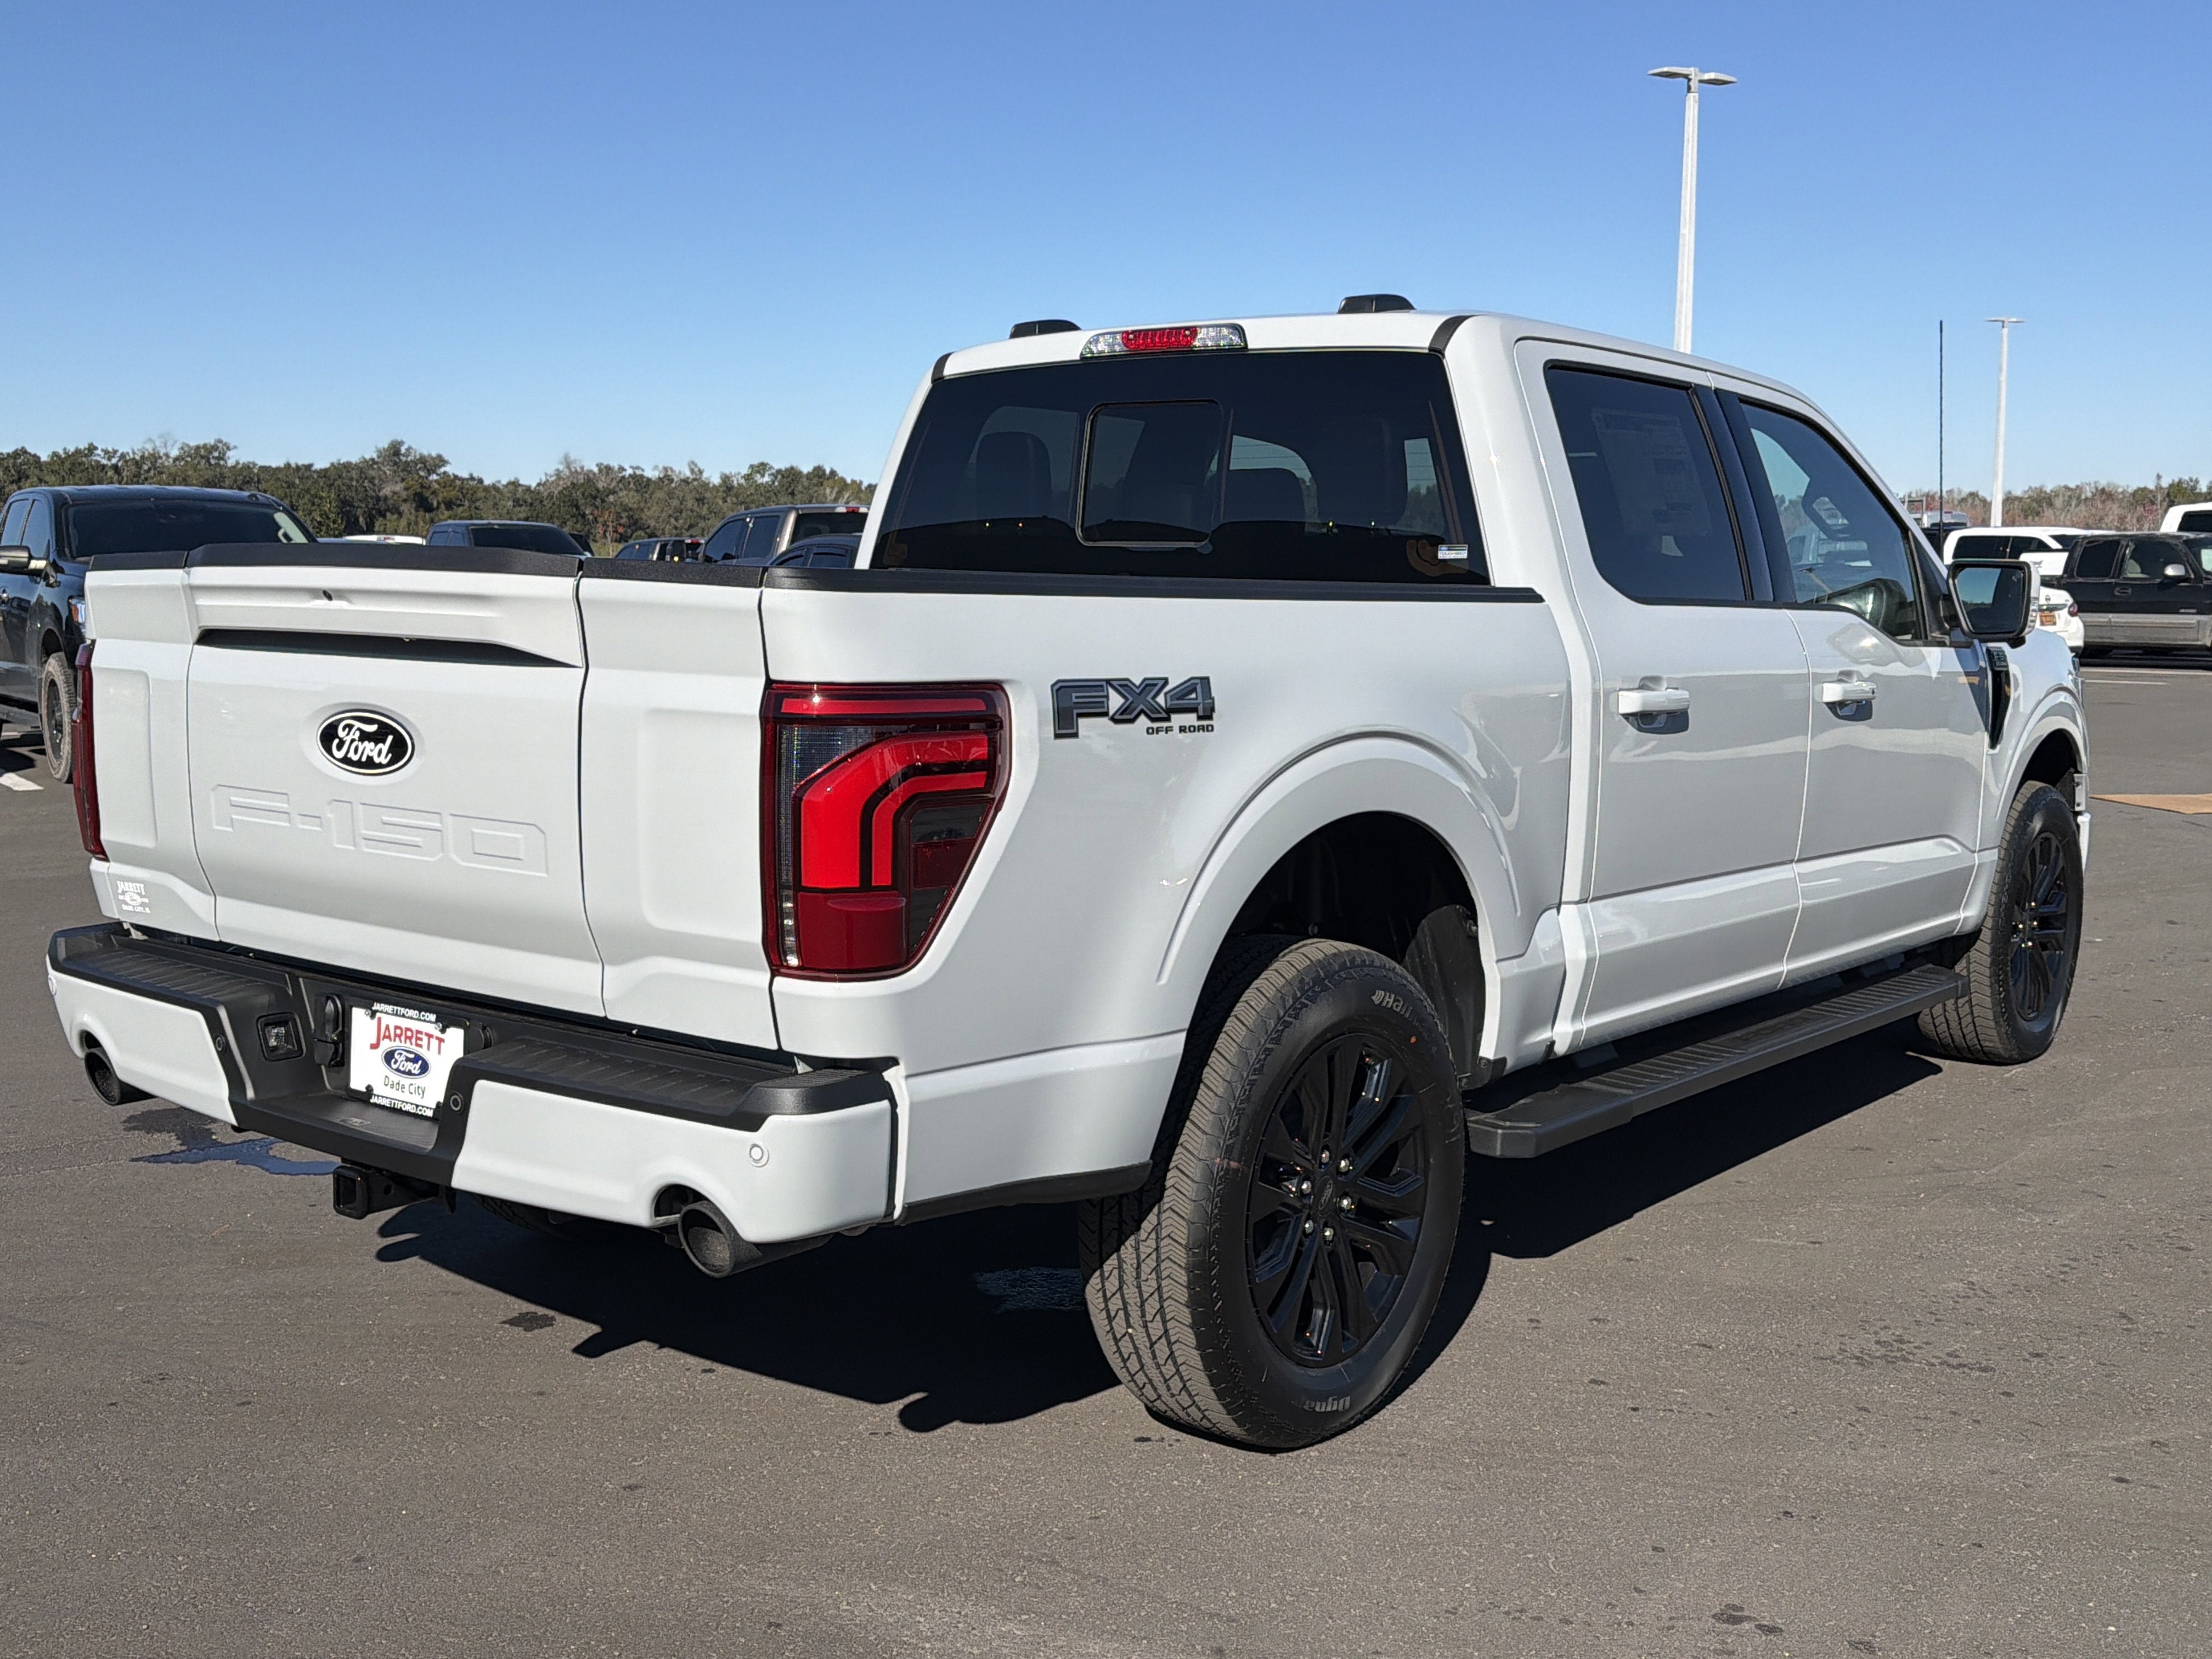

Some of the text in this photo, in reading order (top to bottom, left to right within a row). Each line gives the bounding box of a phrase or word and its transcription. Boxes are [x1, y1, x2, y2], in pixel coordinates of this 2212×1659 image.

[1051, 676, 1215, 740] FX4
[332, 719, 393, 764] Ford
[1146, 724, 1215, 735] OFF ROAD
[210, 784, 549, 877] F-150
[372, 1002, 437, 1022] JARRETTFORD.COM
[370, 1017, 445, 1055] JARRETT
[391, 1049, 422, 1074] Ford
[383, 1075, 426, 1099] Dade City
[370, 1094, 433, 1118] JARRETTFORD.COM
